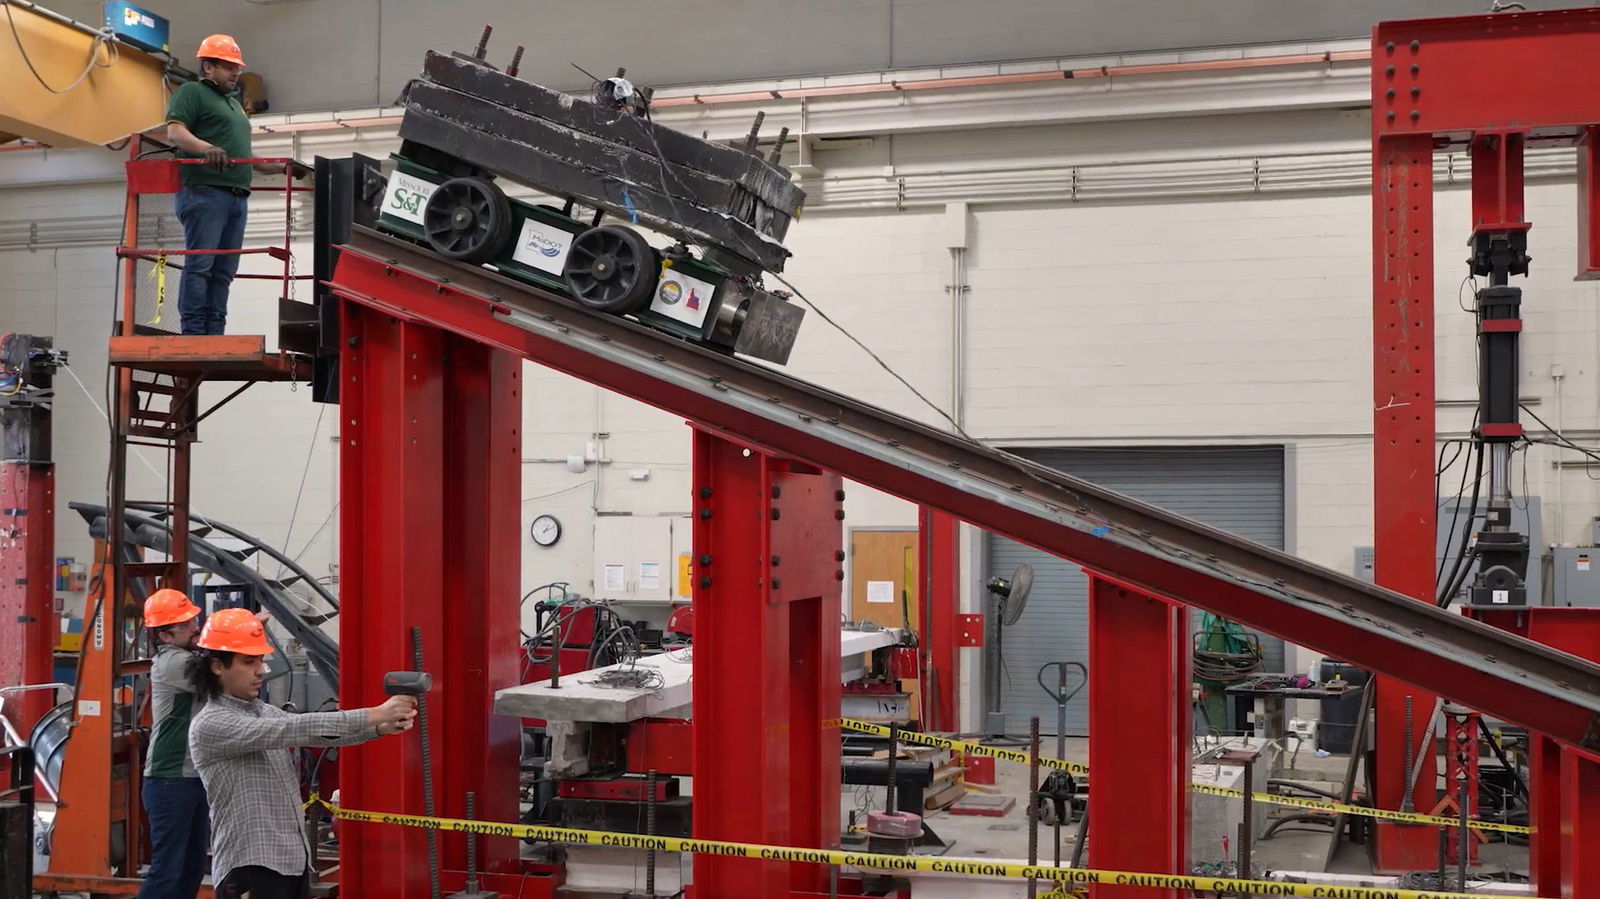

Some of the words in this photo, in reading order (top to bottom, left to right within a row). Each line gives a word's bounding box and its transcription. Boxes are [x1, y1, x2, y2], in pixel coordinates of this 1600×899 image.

[391, 188, 427, 216] S&T
[1497, 592, 1504, 602] 1
[964, 743, 1026, 763] CAUTION
[1039, 758, 1090, 774] AUTION
[453, 822, 514, 837] CAUTION
[526, 828, 589, 844] CAUTION
[601, 834, 666, 850] CAUTION
[680, 841, 747, 857] CAUTION
[761, 848, 830, 864] CAUTION
[845, 855, 917, 870] CAUTION
[931, 861, 1007, 877] CAUTION
[1022, 868, 1099, 883] CAUTION
[1116, 874, 1196, 890] CAUTION
[1213, 881, 1295, 896] CAUTION
